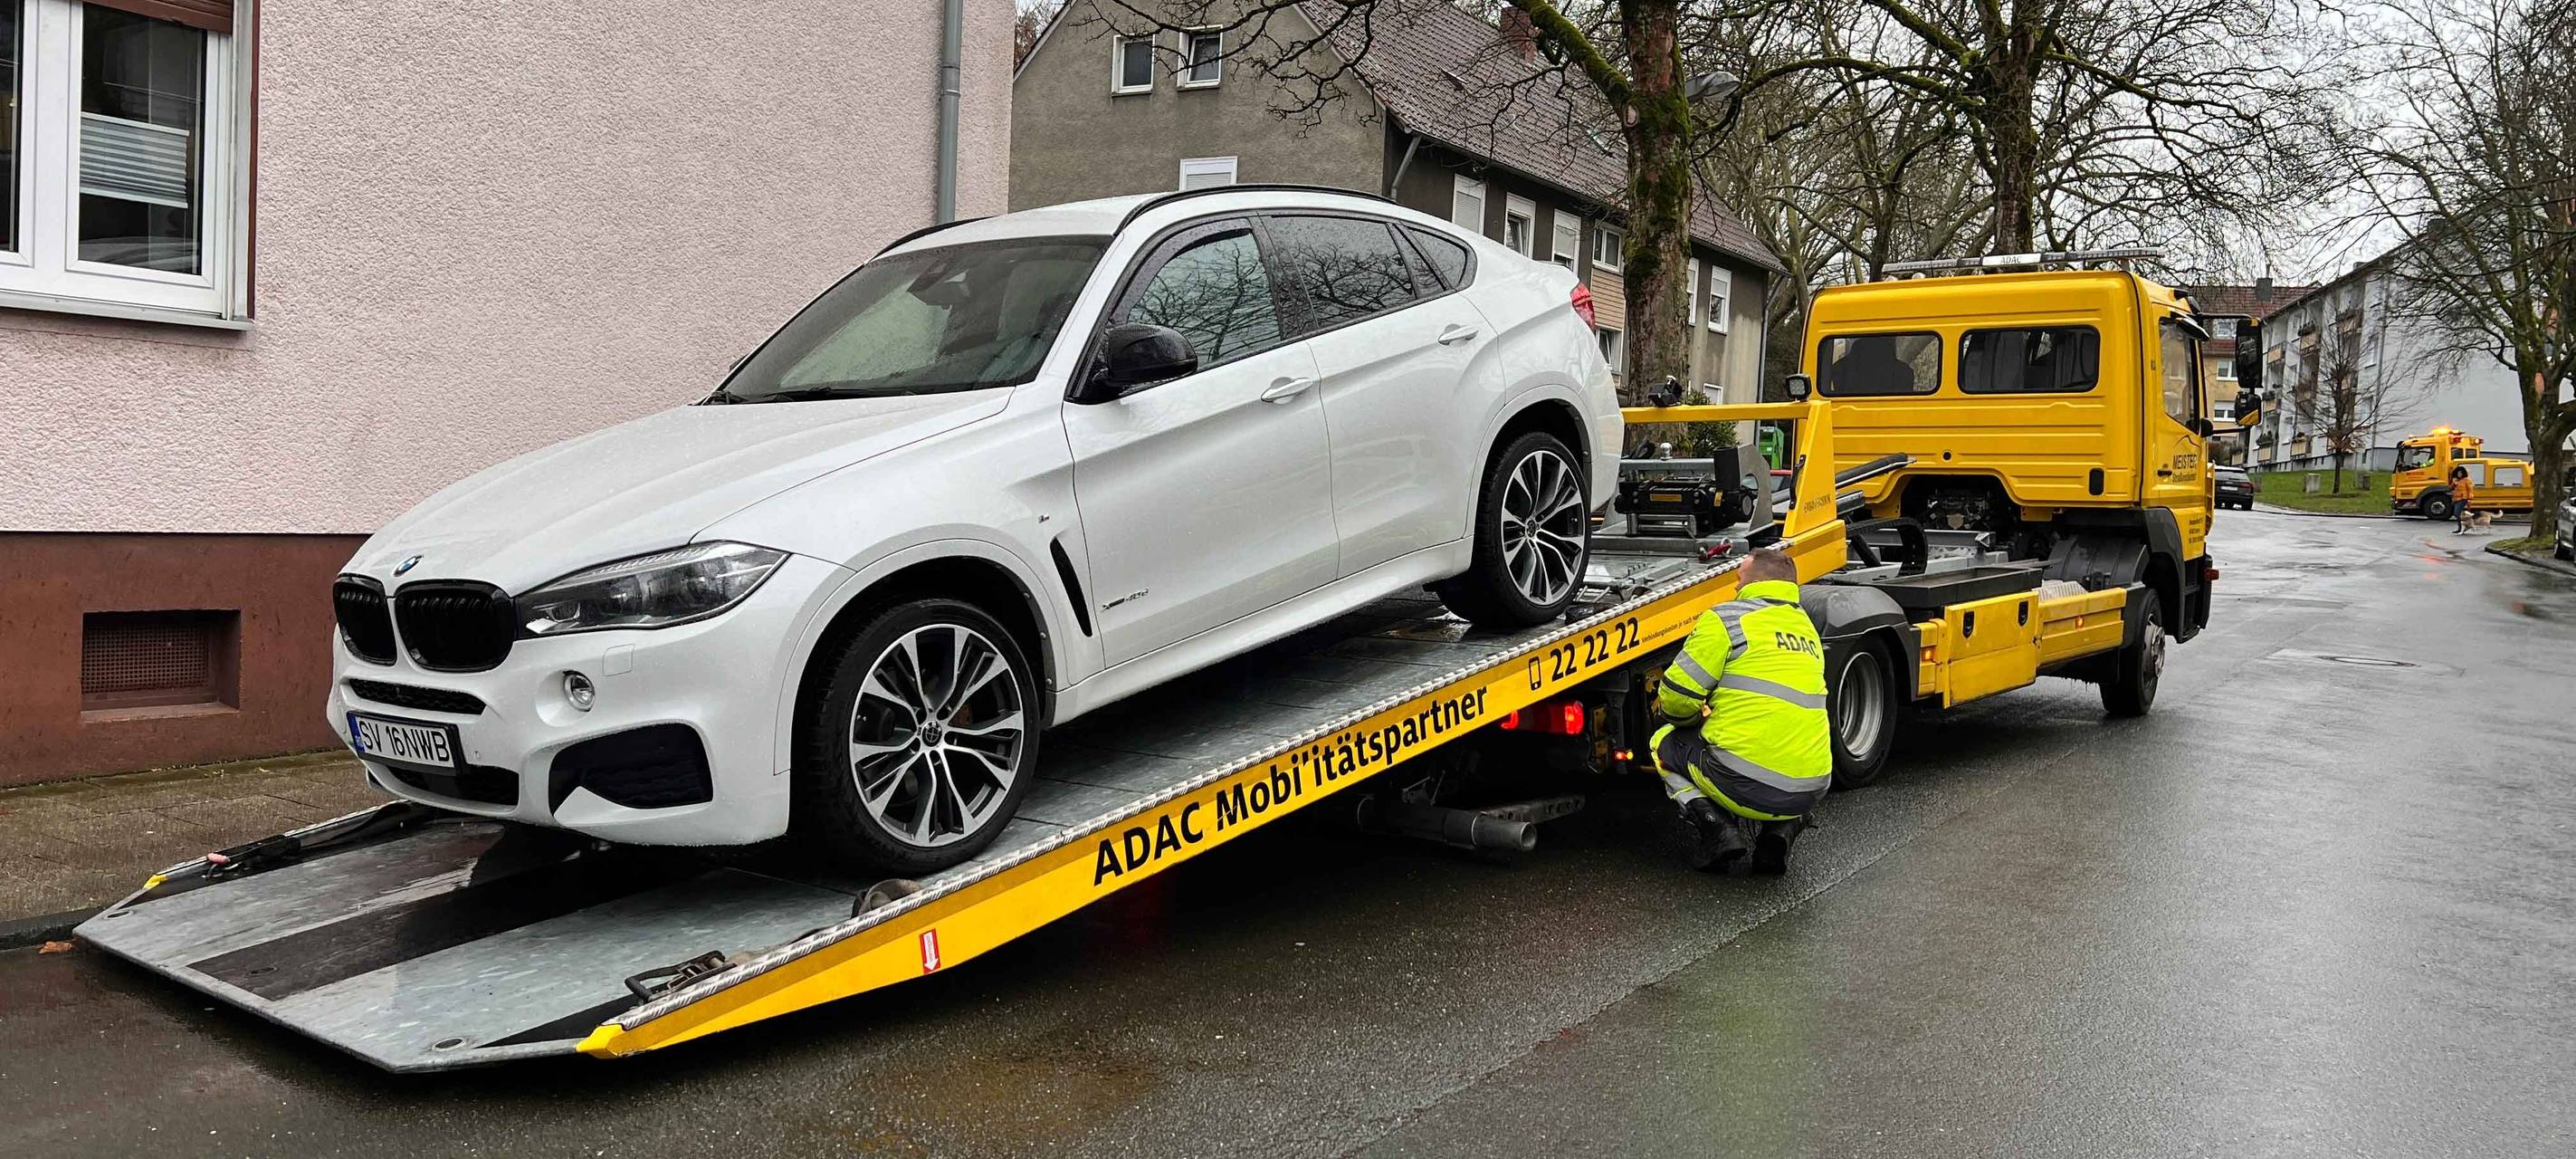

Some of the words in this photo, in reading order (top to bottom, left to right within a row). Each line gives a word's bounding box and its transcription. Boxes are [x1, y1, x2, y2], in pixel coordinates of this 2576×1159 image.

[2000, 255, 2020, 263] ADAC
[1550, 643, 1577, 682] 22
[1584, 629, 1608, 668] 22
[1616, 617, 1640, 655] 22
[1775, 631, 1819, 659] ADAC
[358, 721, 382, 752] SV
[386, 725, 450, 762] 16NWB
[1093, 801, 1204, 886] ADAC
